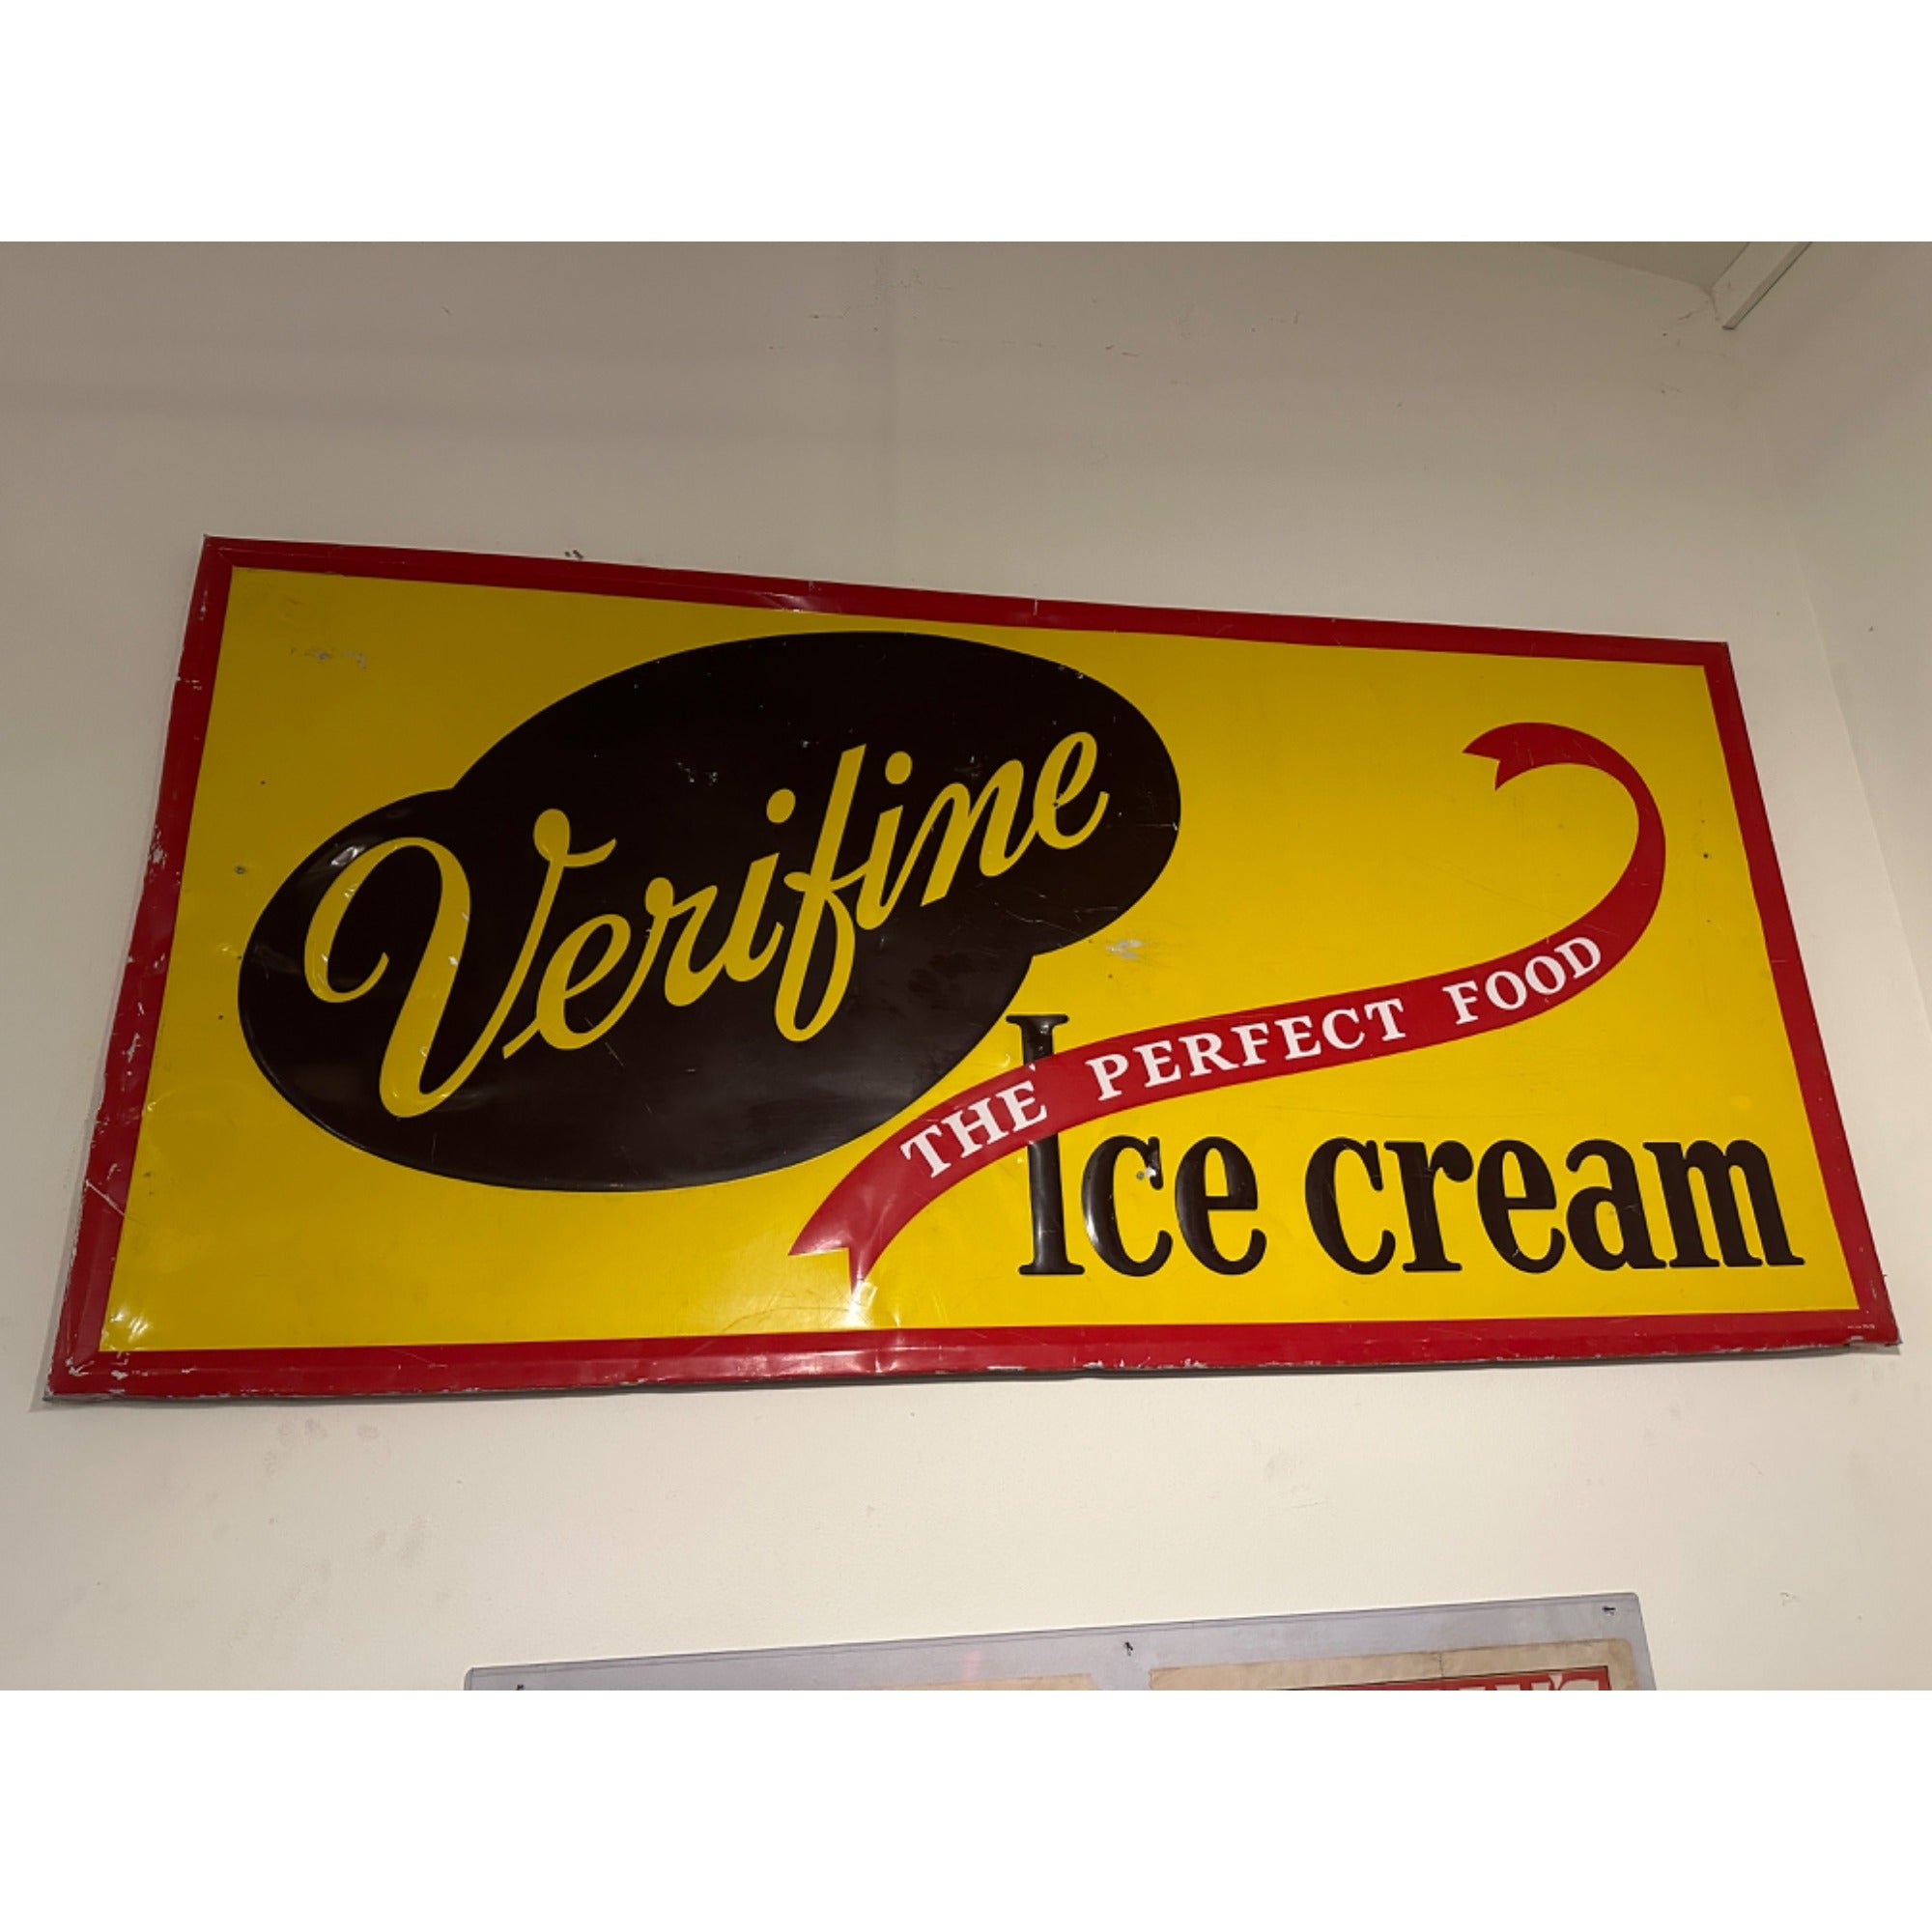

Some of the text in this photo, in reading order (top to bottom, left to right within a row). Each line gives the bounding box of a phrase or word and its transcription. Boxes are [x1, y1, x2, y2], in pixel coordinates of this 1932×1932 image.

[303, 731, 1109, 1118] Verifine
[899, 936, 1603, 1179] THE PERFECT FOOD
[1006, 1014, 1804, 1276] Ice cream
